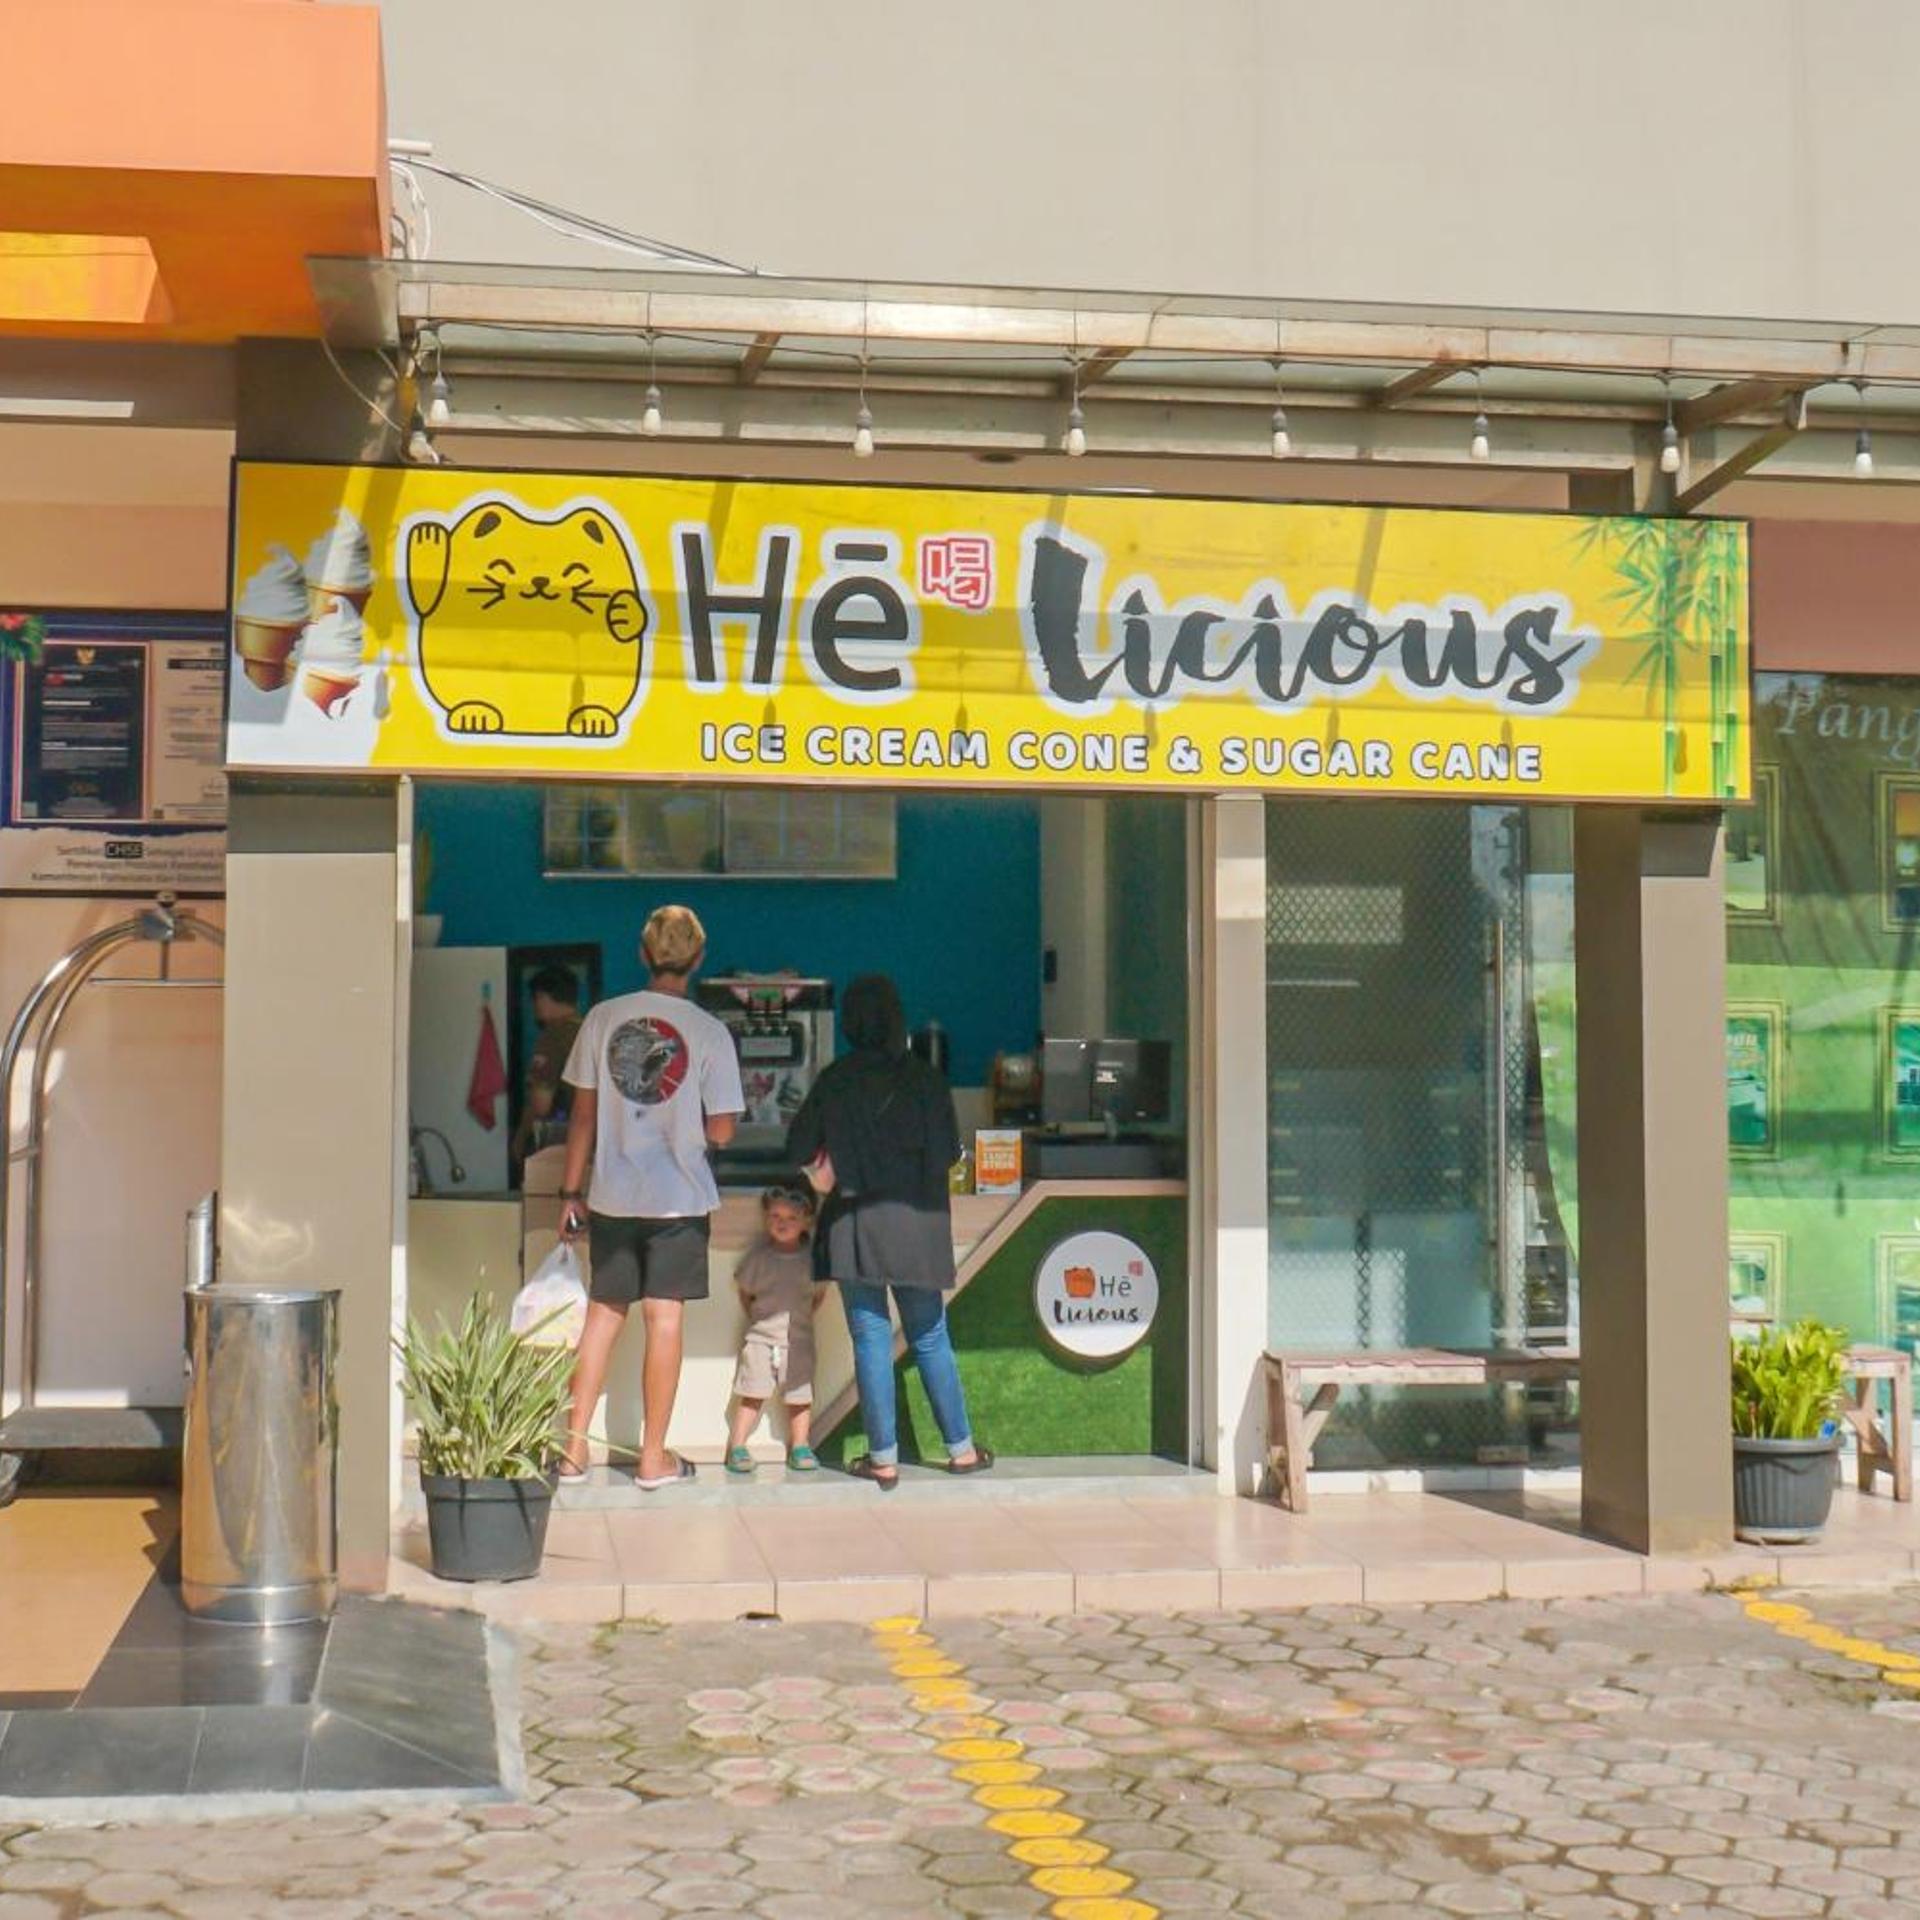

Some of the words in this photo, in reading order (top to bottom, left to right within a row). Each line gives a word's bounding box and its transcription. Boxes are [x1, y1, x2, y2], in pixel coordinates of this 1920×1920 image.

[700, 722, 787, 764] ICE
[804, 724, 990, 769] CREAM
[1007, 731, 1149, 773] CONE
[1167, 735, 1203, 774] &
[1219, 736, 1393, 778] SUGAR
[1410, 741, 1542, 781] CANE
